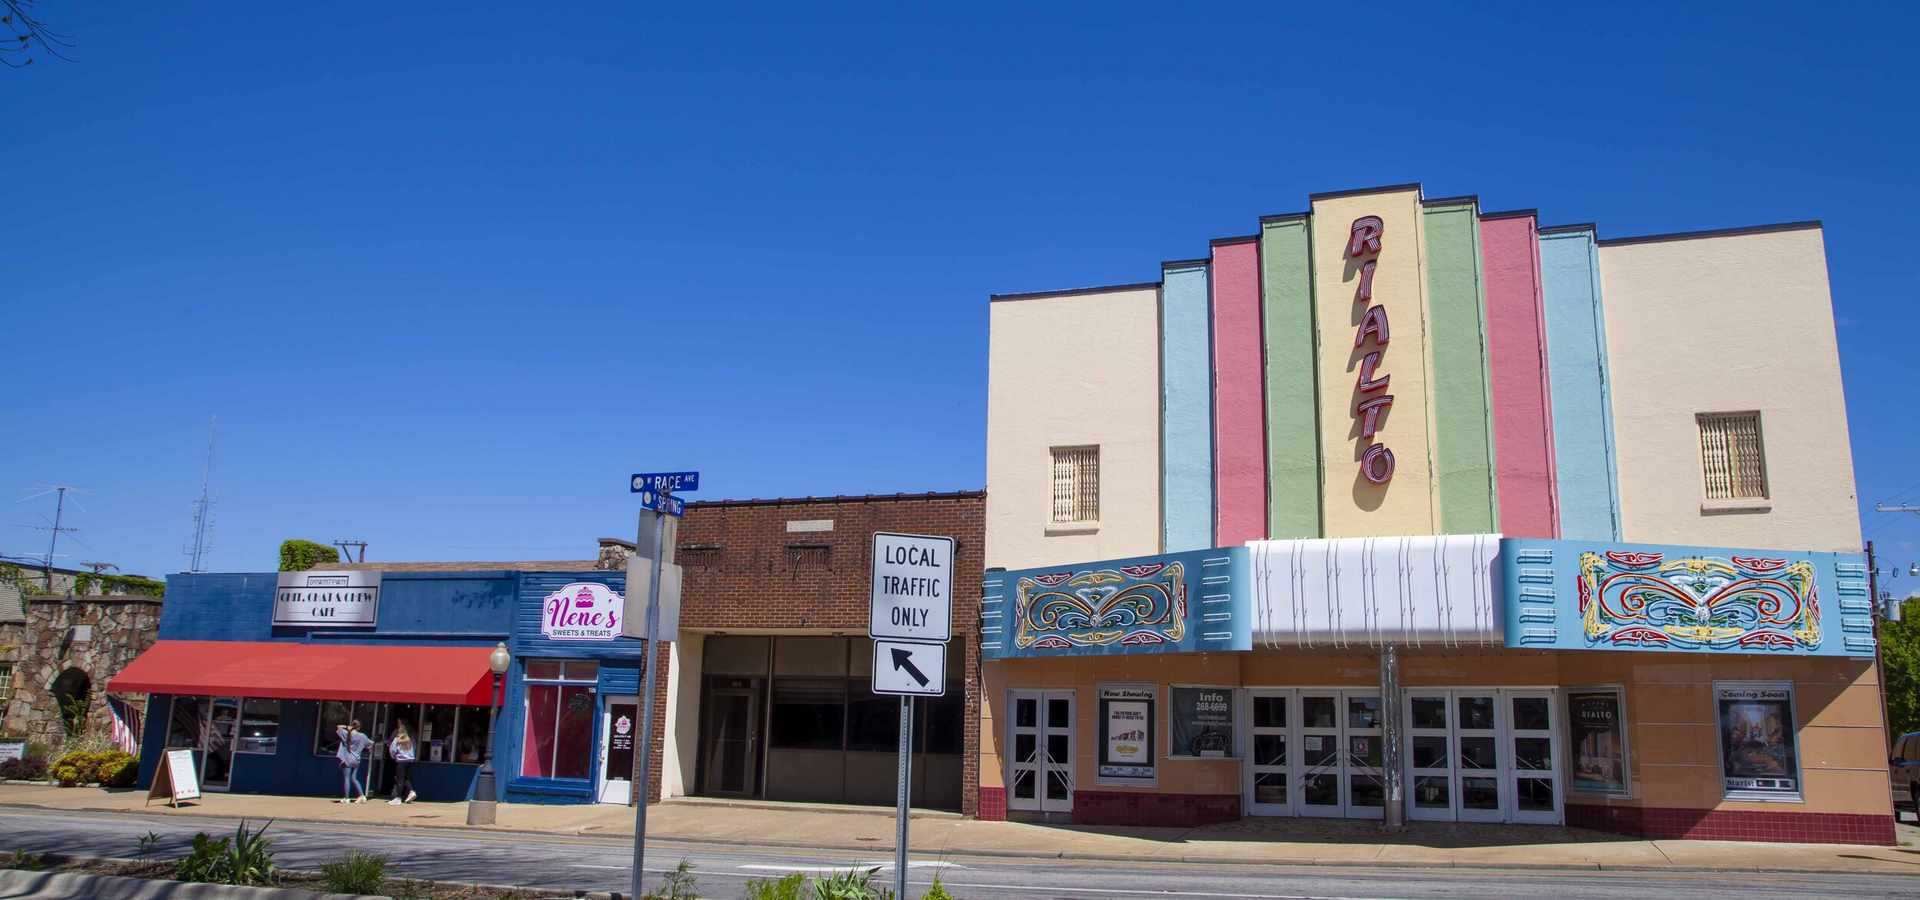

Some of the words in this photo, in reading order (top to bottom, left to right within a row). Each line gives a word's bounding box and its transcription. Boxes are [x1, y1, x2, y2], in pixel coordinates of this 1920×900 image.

[1351, 215, 1395, 484] RIALTO
[654, 475, 681, 489] RACE
[684, 474, 695, 482] AVE
[885, 545, 941, 567] LOCAL
[883, 576, 940, 598] TRAFFIC
[307, 592, 334, 602] CHAT
[344, 592, 372, 602] CHEW
[312, 607, 335, 617] CAFE
[547, 596, 618, 628] Nene's
[891, 606, 929, 627] ONLY
[552, 629, 579, 637] SWEETS
[1122, 689, 1153, 698] Showing
[1200, 692, 1224, 702] Info
[1721, 689, 1758, 699] Coming
[1760, 690, 1785, 698] Soon
[1582, 711, 1612, 719] RIALTO
